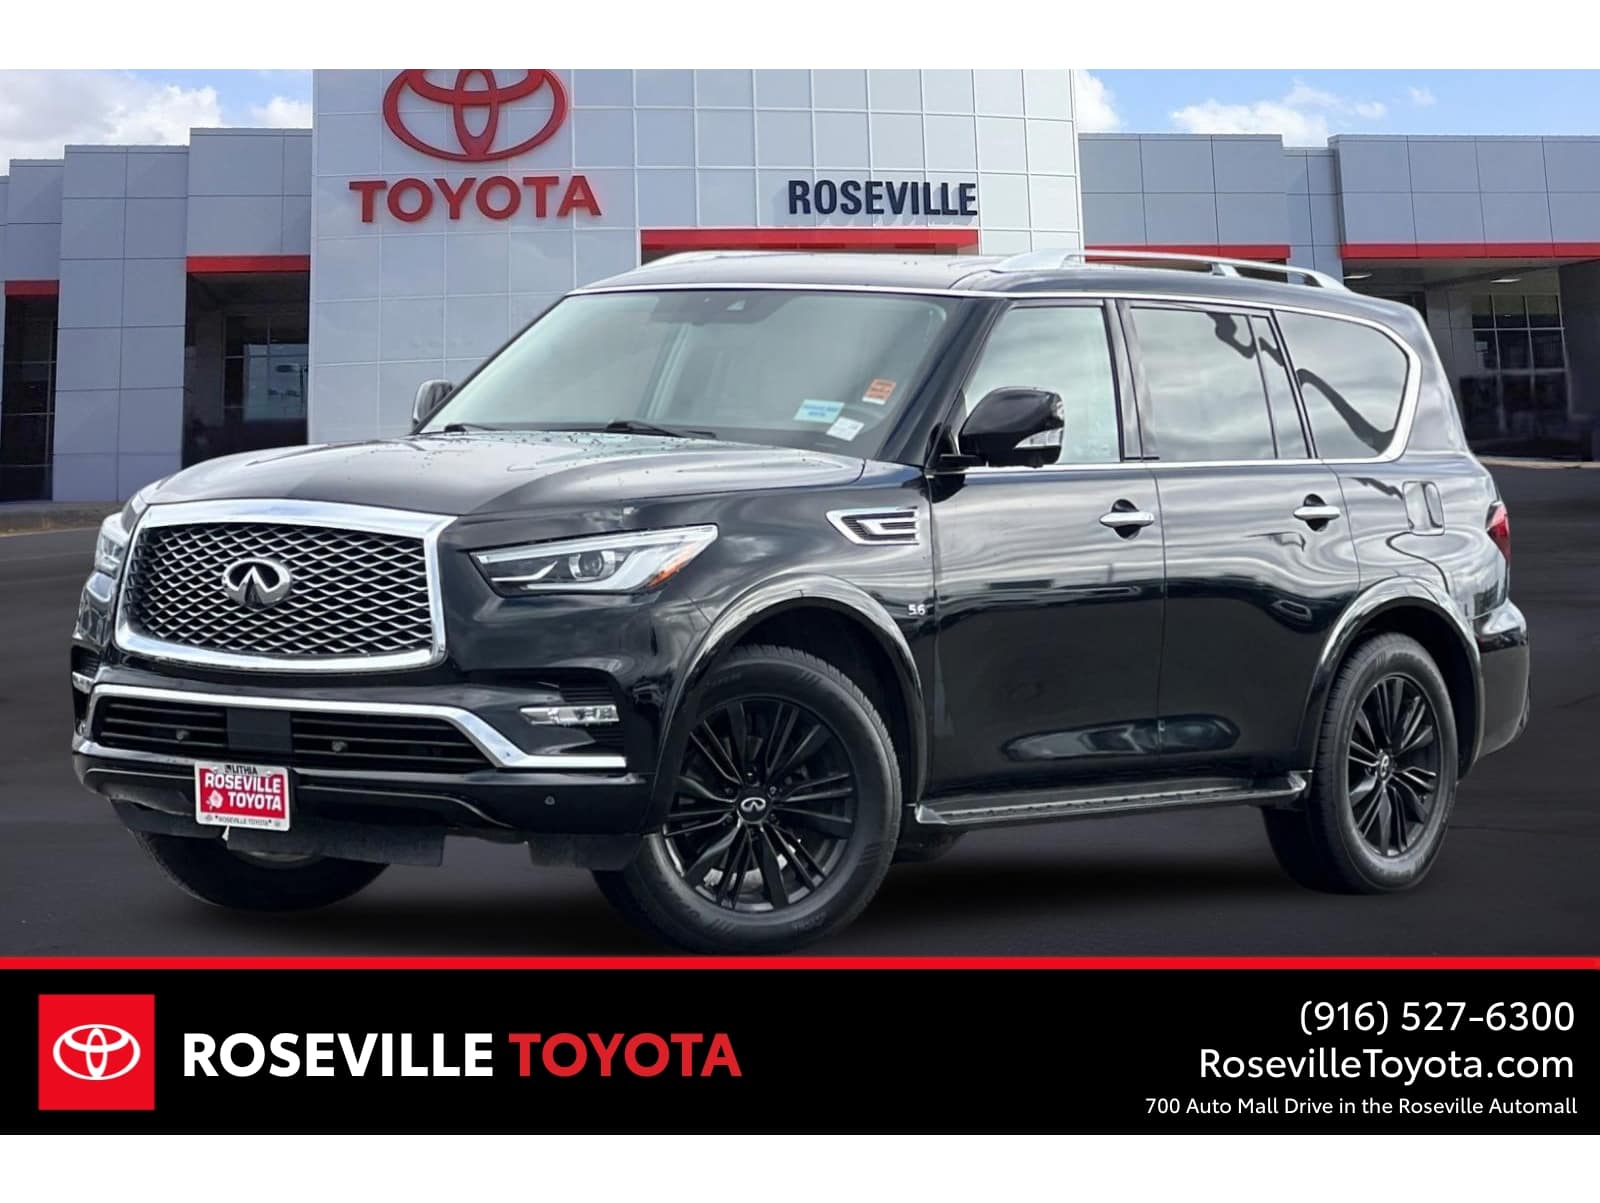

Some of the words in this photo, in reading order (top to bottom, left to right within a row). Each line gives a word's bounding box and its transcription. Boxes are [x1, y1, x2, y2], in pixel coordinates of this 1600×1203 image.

[350, 175, 602, 222] TOYOTA
[788, 180, 978, 216] ROSEVILLE
[231, 764, 258, 775] LITHIA
[204, 772, 282, 793] ROSEVILLE
[227, 791, 282, 811] TOYOTA
